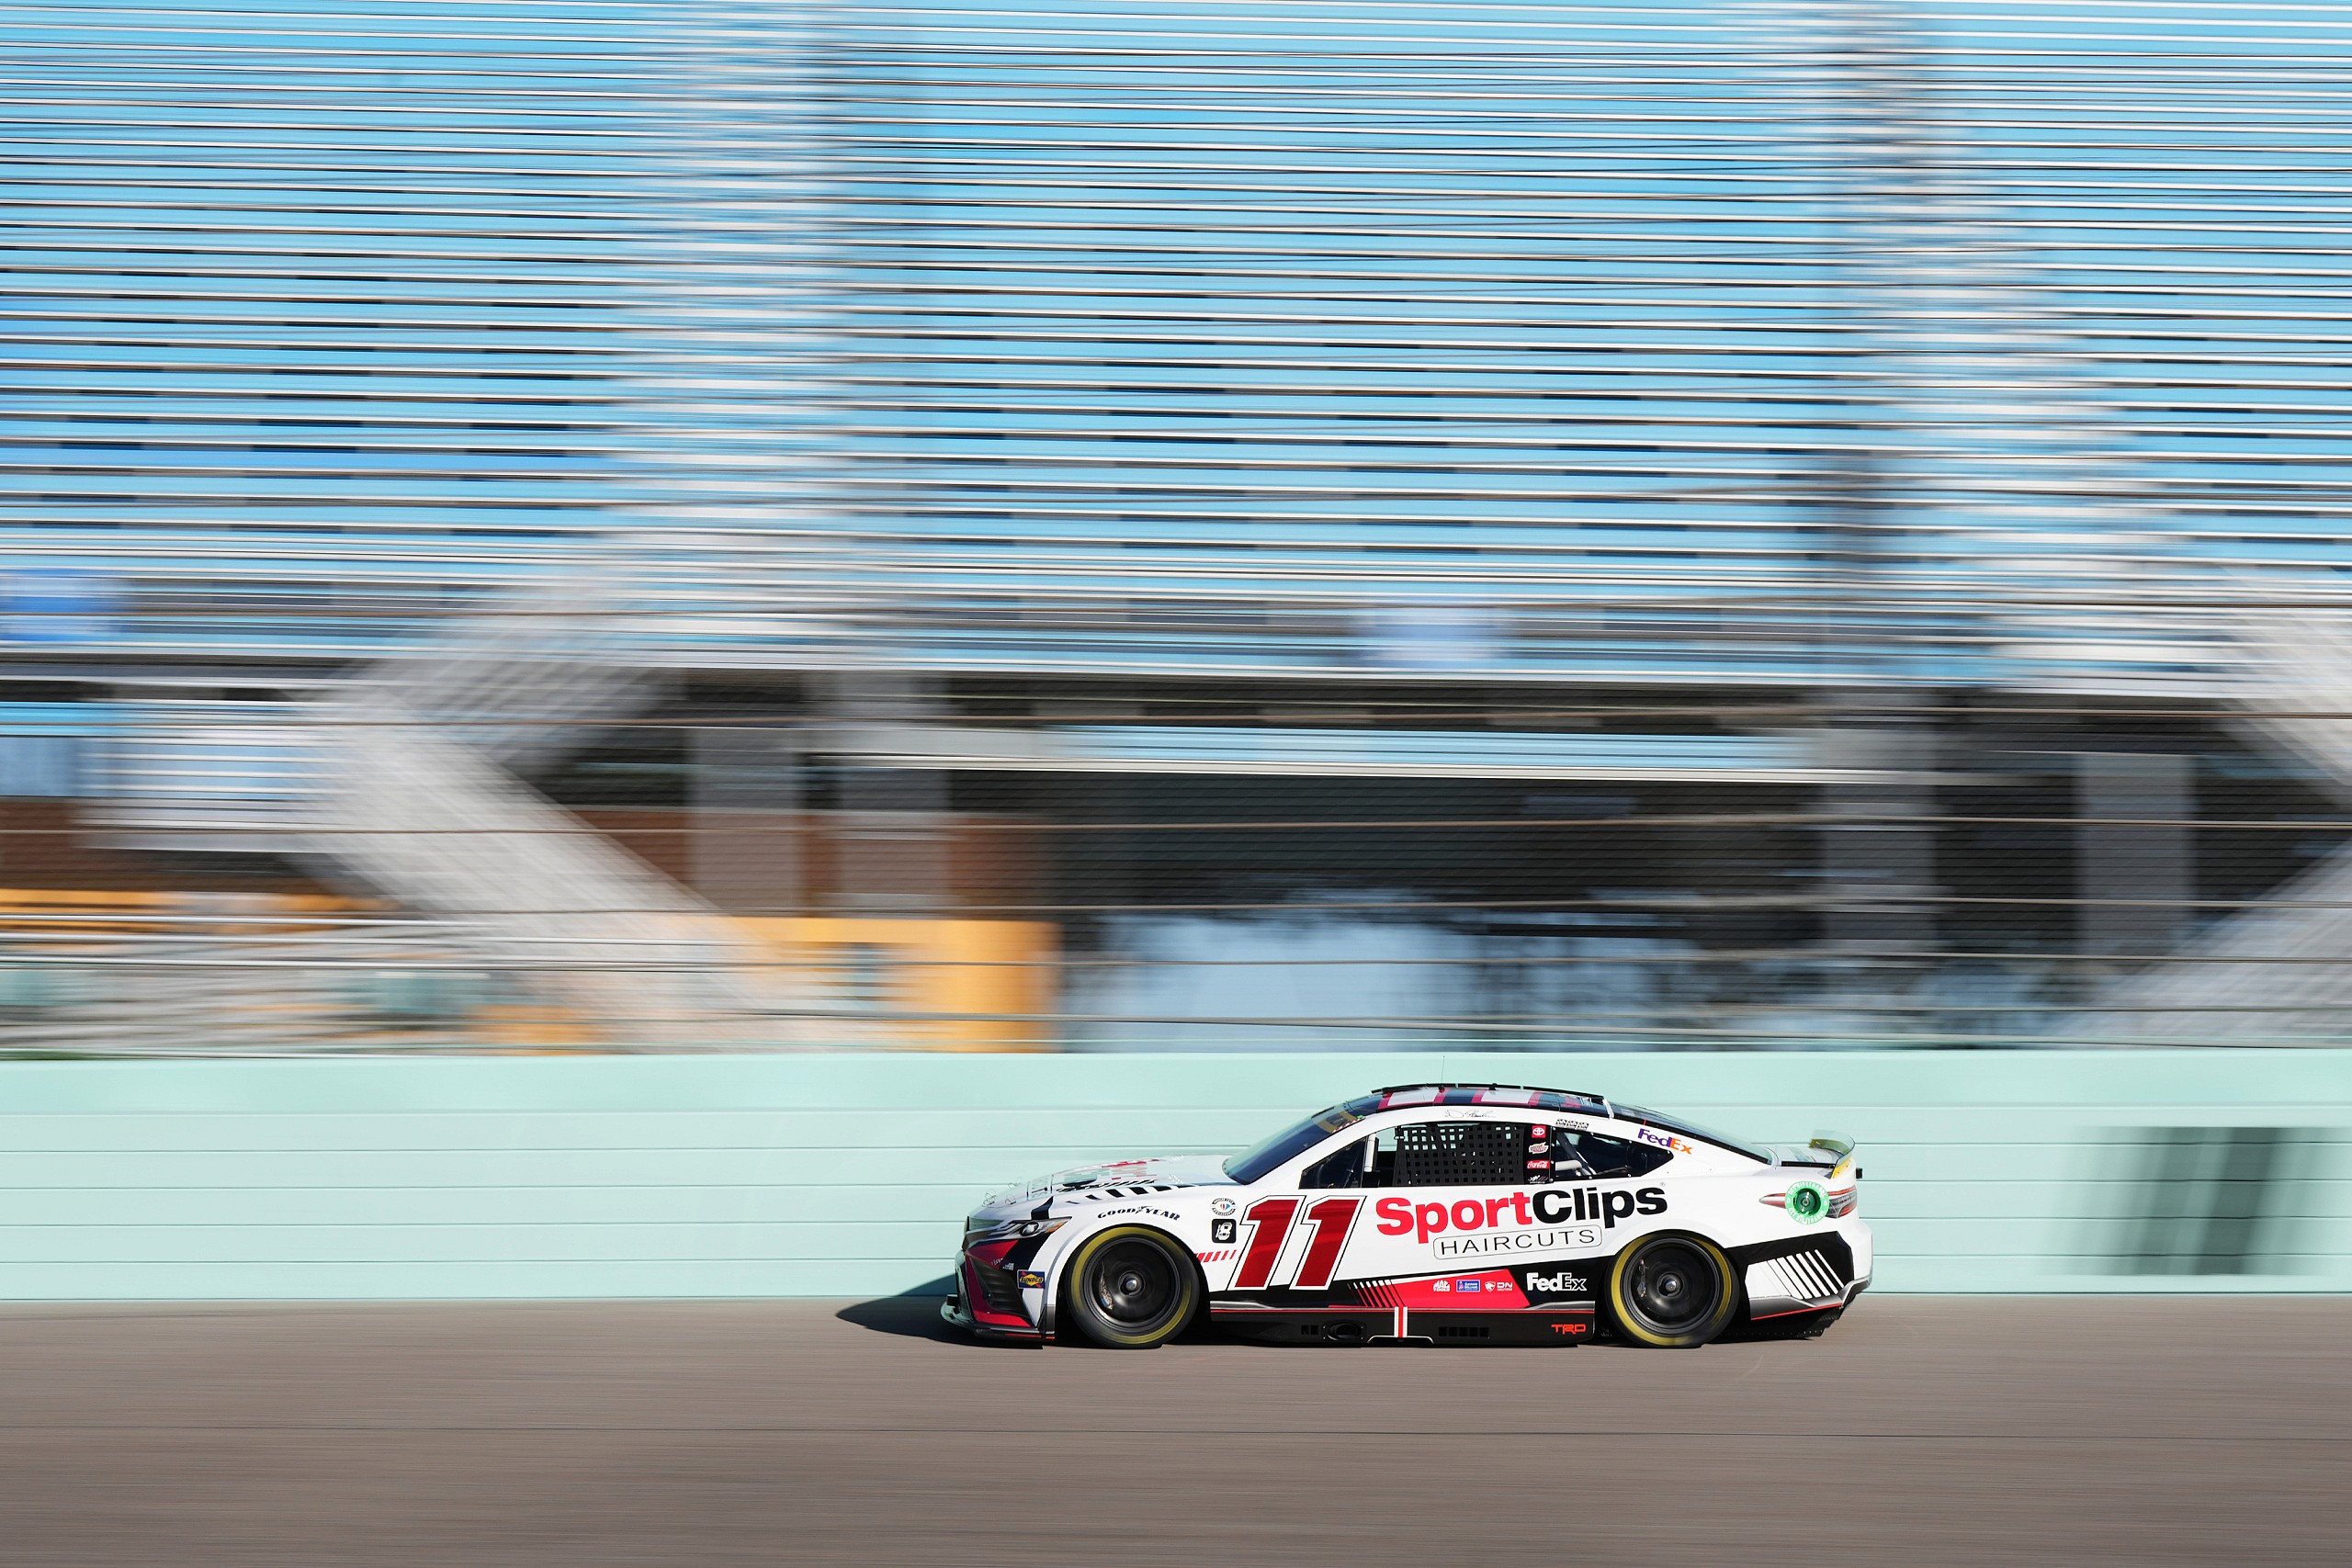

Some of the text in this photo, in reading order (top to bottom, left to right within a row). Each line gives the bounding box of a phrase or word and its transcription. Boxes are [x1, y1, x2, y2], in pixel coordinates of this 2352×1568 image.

[1637, 1128, 1694, 1155] FedEx
[1376, 1186, 1668, 1244] SportClips
[1228, 1195, 1365, 1291] 11
[1440, 1229, 1595, 1255] HAIRCUTS
[1433, 1280, 1451, 1288] MAC
[1526, 1272, 1588, 1292] FedEx
[1550, 1324, 1587, 1335] TRD
